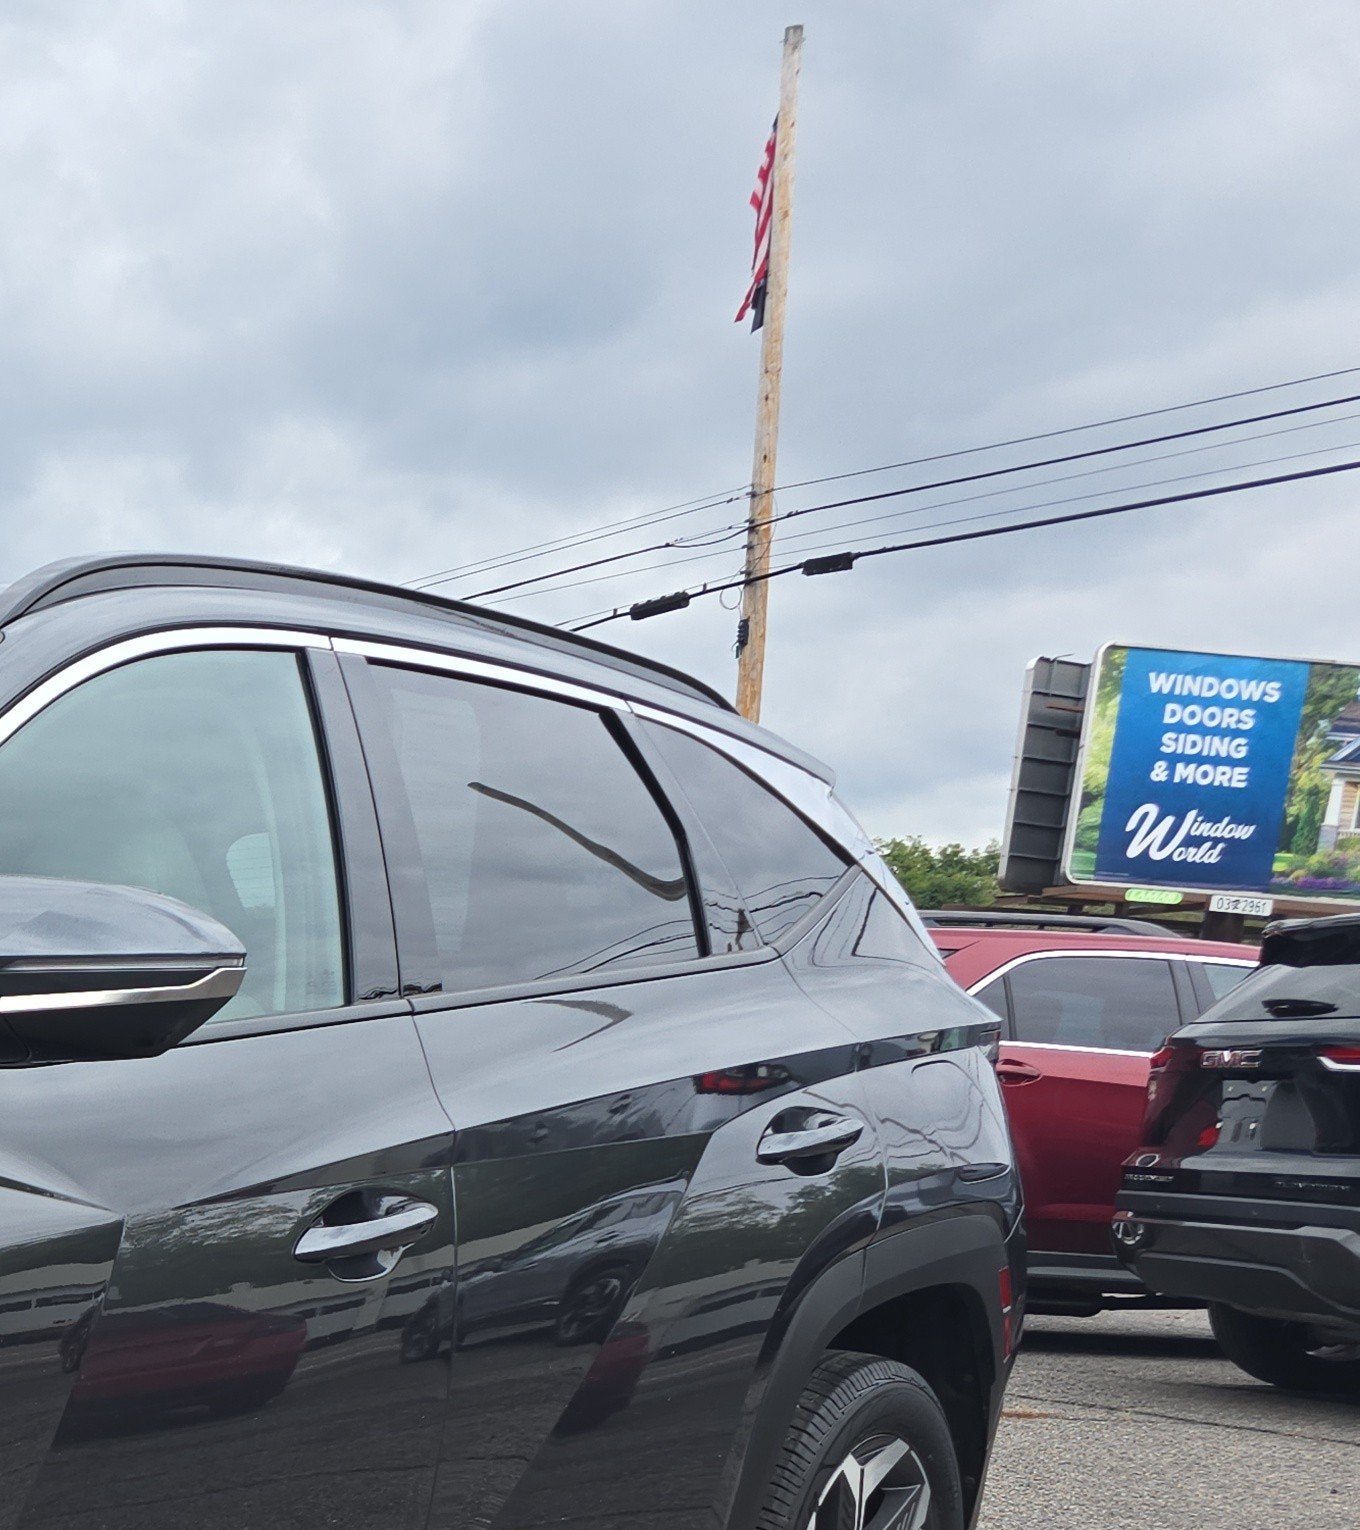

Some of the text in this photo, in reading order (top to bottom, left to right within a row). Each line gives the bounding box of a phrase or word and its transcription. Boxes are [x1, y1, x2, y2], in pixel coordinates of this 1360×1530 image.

[1148, 672, 1282, 703] WINDOWS
[1162, 703, 1257, 730] DOORS
[1160, 732, 1249, 758] SIDING
[1150, 760, 1250, 788] & MORE
[1125, 803, 1257, 862] Window
[1200, 1048, 1264, 1068] GMC
